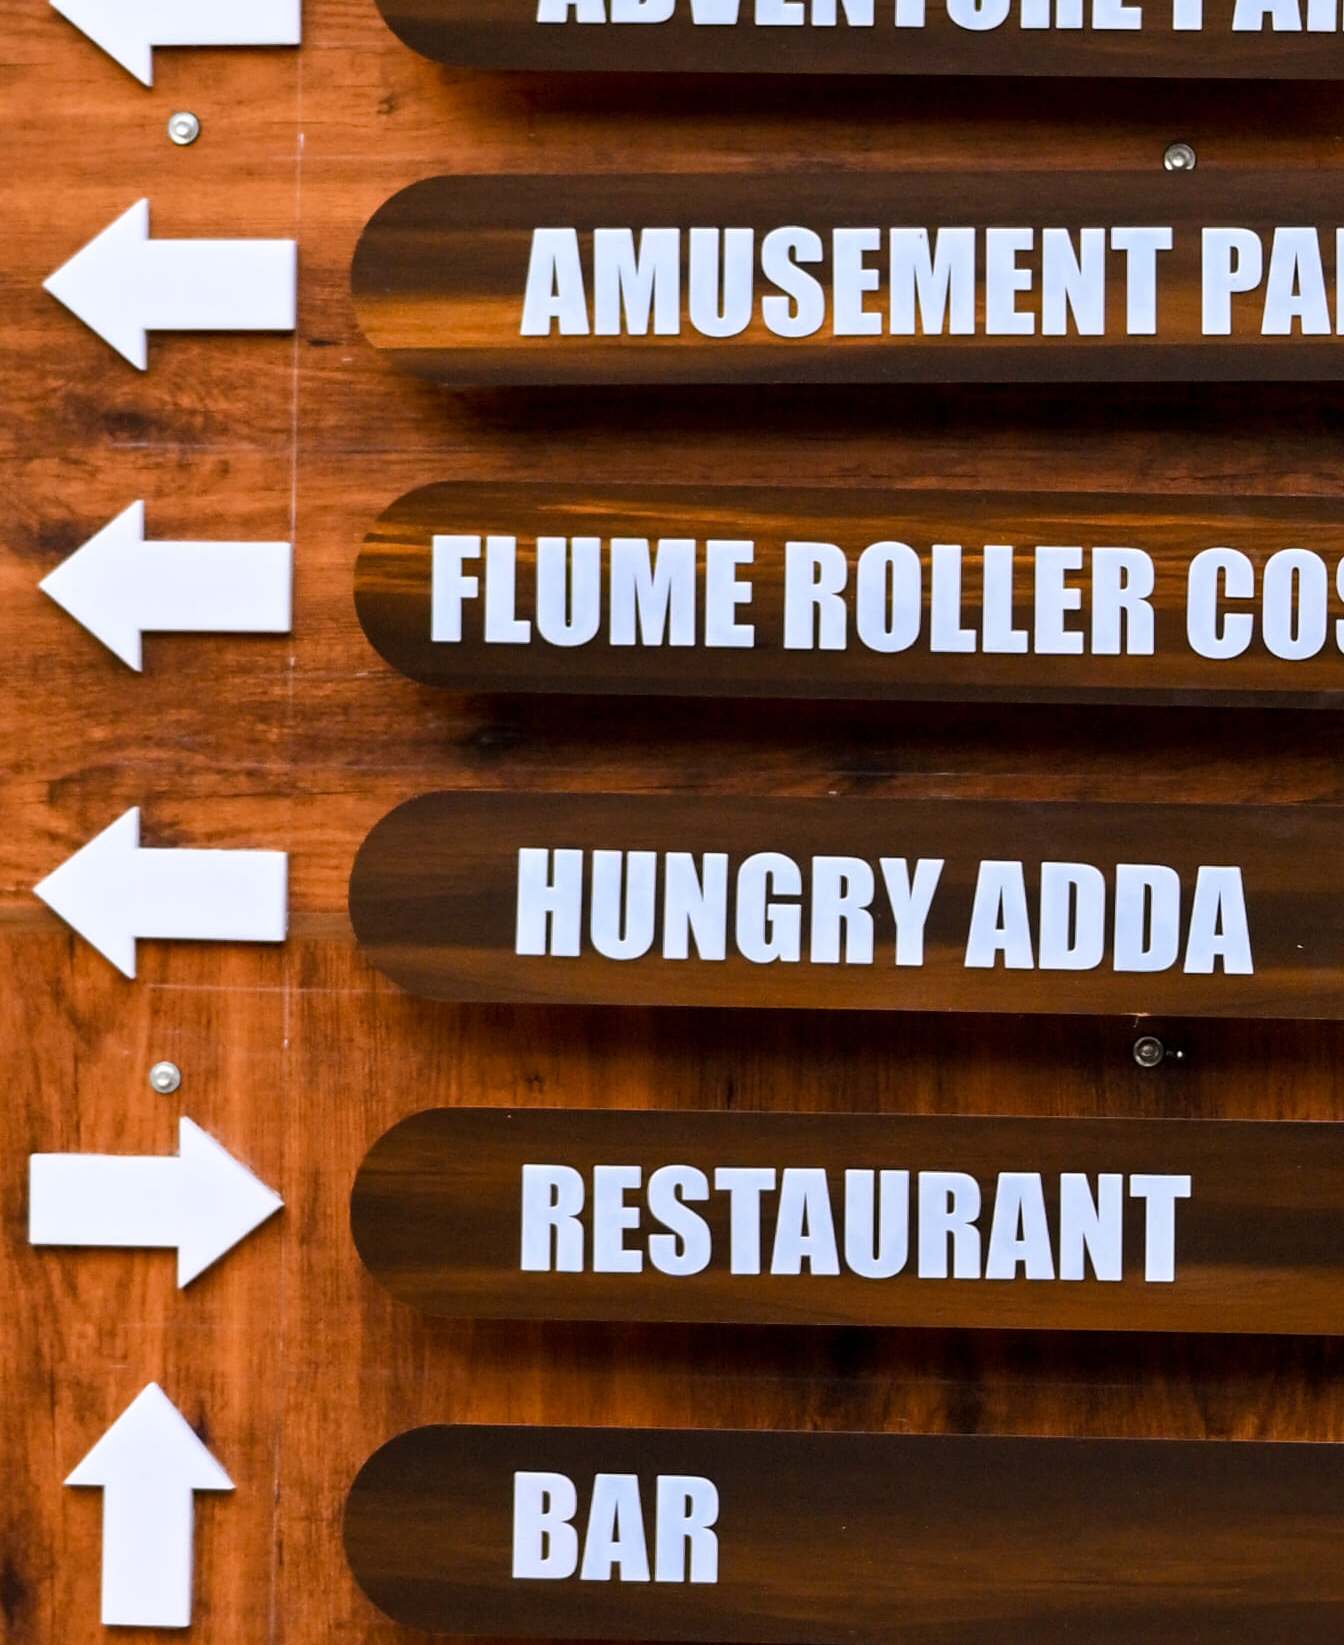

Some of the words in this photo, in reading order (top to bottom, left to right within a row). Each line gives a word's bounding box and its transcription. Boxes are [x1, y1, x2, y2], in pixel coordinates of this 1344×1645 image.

[520, 226, 1172, 337] AMUSEMENT
[432, 535, 754, 647] FLUME
[784, 541, 1154, 654] ROLLER
[516, 848, 944, 965] HUNGRY
[965, 861, 1253, 974] ADDA
[521, 1164, 1191, 1281] RESTAURANT
[513, 1472, 718, 1583] BAR
